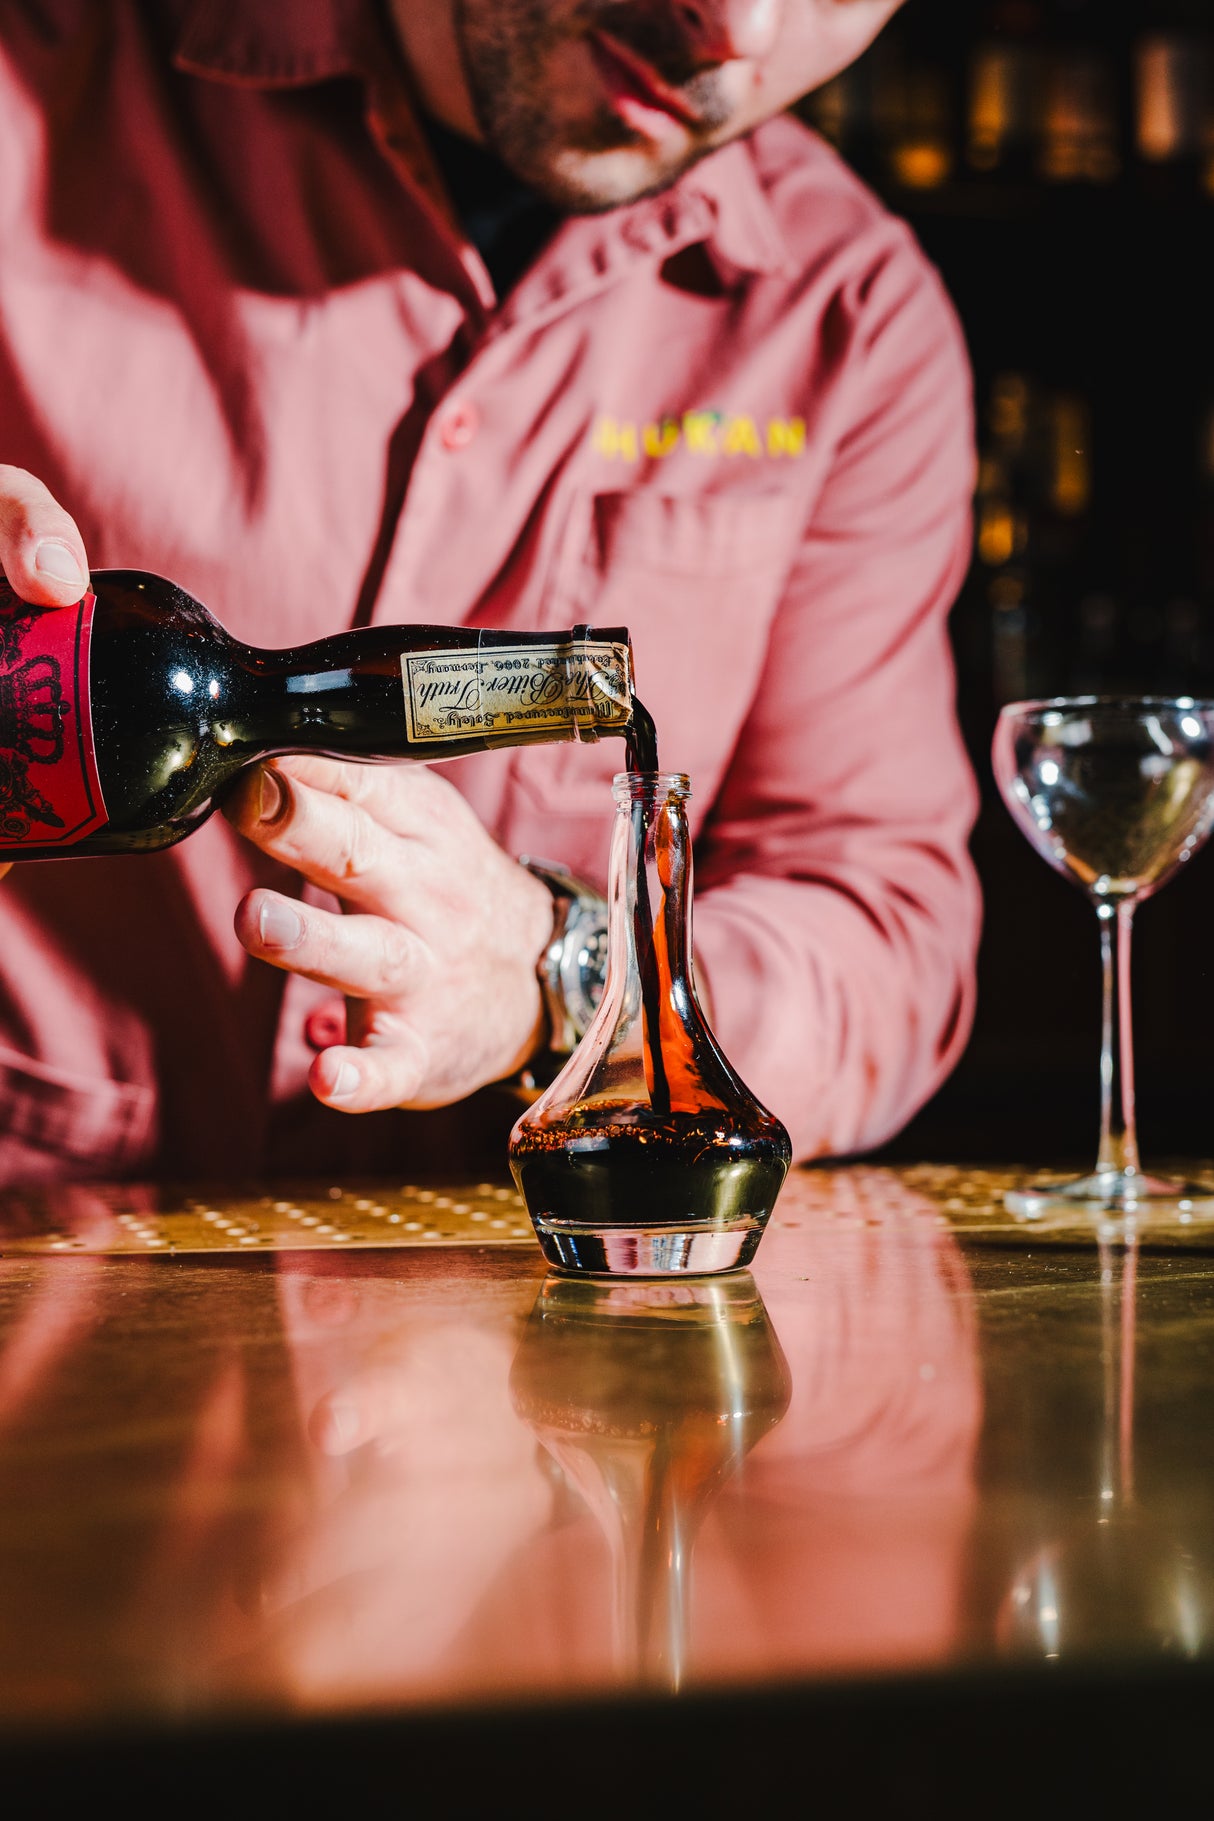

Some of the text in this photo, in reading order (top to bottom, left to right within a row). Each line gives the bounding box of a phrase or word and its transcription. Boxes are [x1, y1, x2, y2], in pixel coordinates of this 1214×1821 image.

[417, 670, 611, 712] The Bitter Truth
